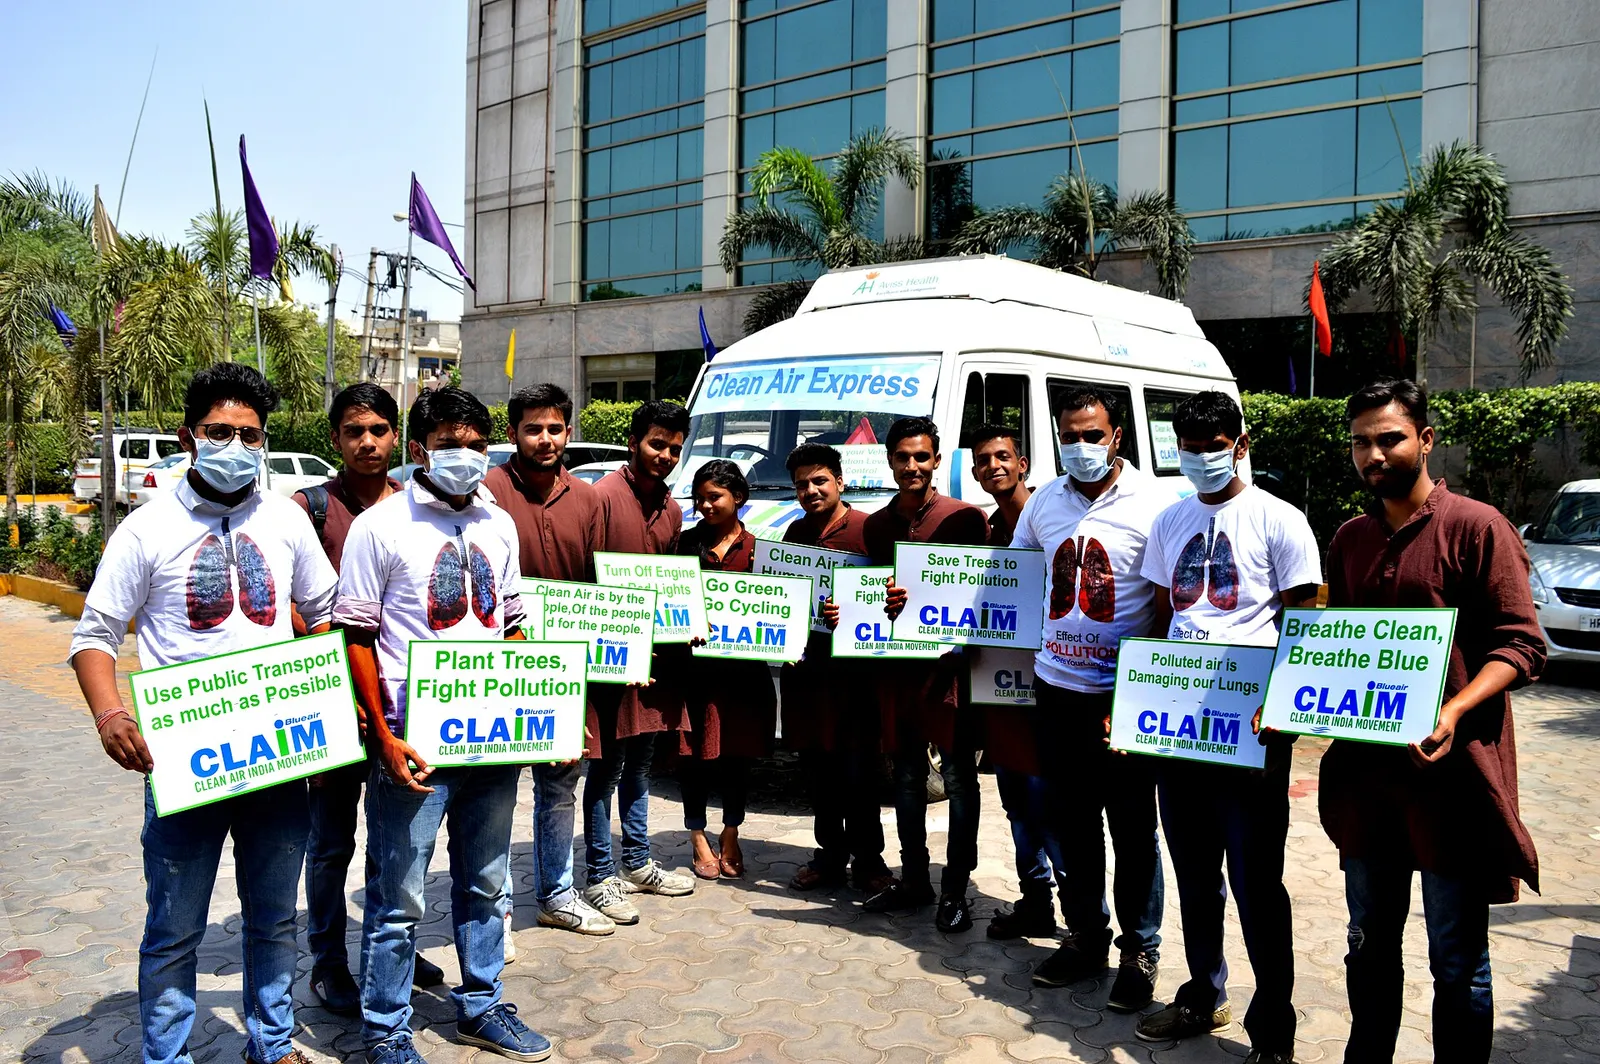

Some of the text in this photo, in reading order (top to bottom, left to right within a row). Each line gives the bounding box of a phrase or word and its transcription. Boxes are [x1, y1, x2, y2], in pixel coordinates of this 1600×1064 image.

[905, 276, 939, 286] Health
[706, 366, 921, 400] Clean Air Express
[769, 548, 812, 567] Clean
[815, 555, 838, 570] Air
[927, 553, 1018, 570] Save Trees to
[603, 564, 696, 581] Turn Off Engine
[860, 575, 887, 587] Save
[921, 571, 1019, 587] Fight Pollution
[536, 584, 645, 605] Clean Air is by the
[655, 583, 691, 598] Lights
[706, 578, 788, 599] Go Green,
[855, 591, 885, 605] Fight
[589, 605, 608, 617] the
[611, 608, 651, 622] people
[704, 597, 724, 611] Go
[729, 599, 791, 619] Cycling
[558, 617, 576, 630] for
[578, 619, 597, 631] the
[601, 621, 644, 636] people.
[918, 625, 1016, 640] CLEAN AIR INDIA MOVEMENT
[1196, 629, 1210, 640] Of
[1285, 618, 1443, 645] Breathe Clean,
[1056, 630, 1100, 643] Effect Of
[721, 643, 733, 651] AIR
[733, 644, 750, 652] INDIA
[751, 645, 785, 654] MOVEMENT
[854, 642, 940, 651] CLEAN AIR INDIA MOVEMENT
[435, 650, 495, 670] Plant
[501, 650, 567, 672] Trees,
[1151, 653, 1237, 672] Polluted air is
[1288, 645, 1429, 671] Breathe Blue
[144, 648, 340, 706] Use Public Transport
[591, 665, 627, 675] MOVEMENT
[416, 678, 581, 703] Fight Pollution
[1128, 669, 1259, 696] Damaging our Lungs
[1375, 682, 1409, 690] Blueair
[151, 672, 342, 730] as much as Possible
[994, 689, 1015, 698] CLEAN
[1016, 690, 1028, 698] AIR
[284, 711, 321, 726] Blueair
[1210, 710, 1241, 719] Blueair
[1290, 711, 1403, 733] CLEAN AIR INDIA MOVEMENT
[438, 741, 554, 756] CLEAN AIR INDIA MOVEMENT
[1135, 733, 1238, 756] CLEAN AIR INDIA MOVEMENT
[194, 747, 329, 793] CLEAN AIR INDIA MOVEMENT
